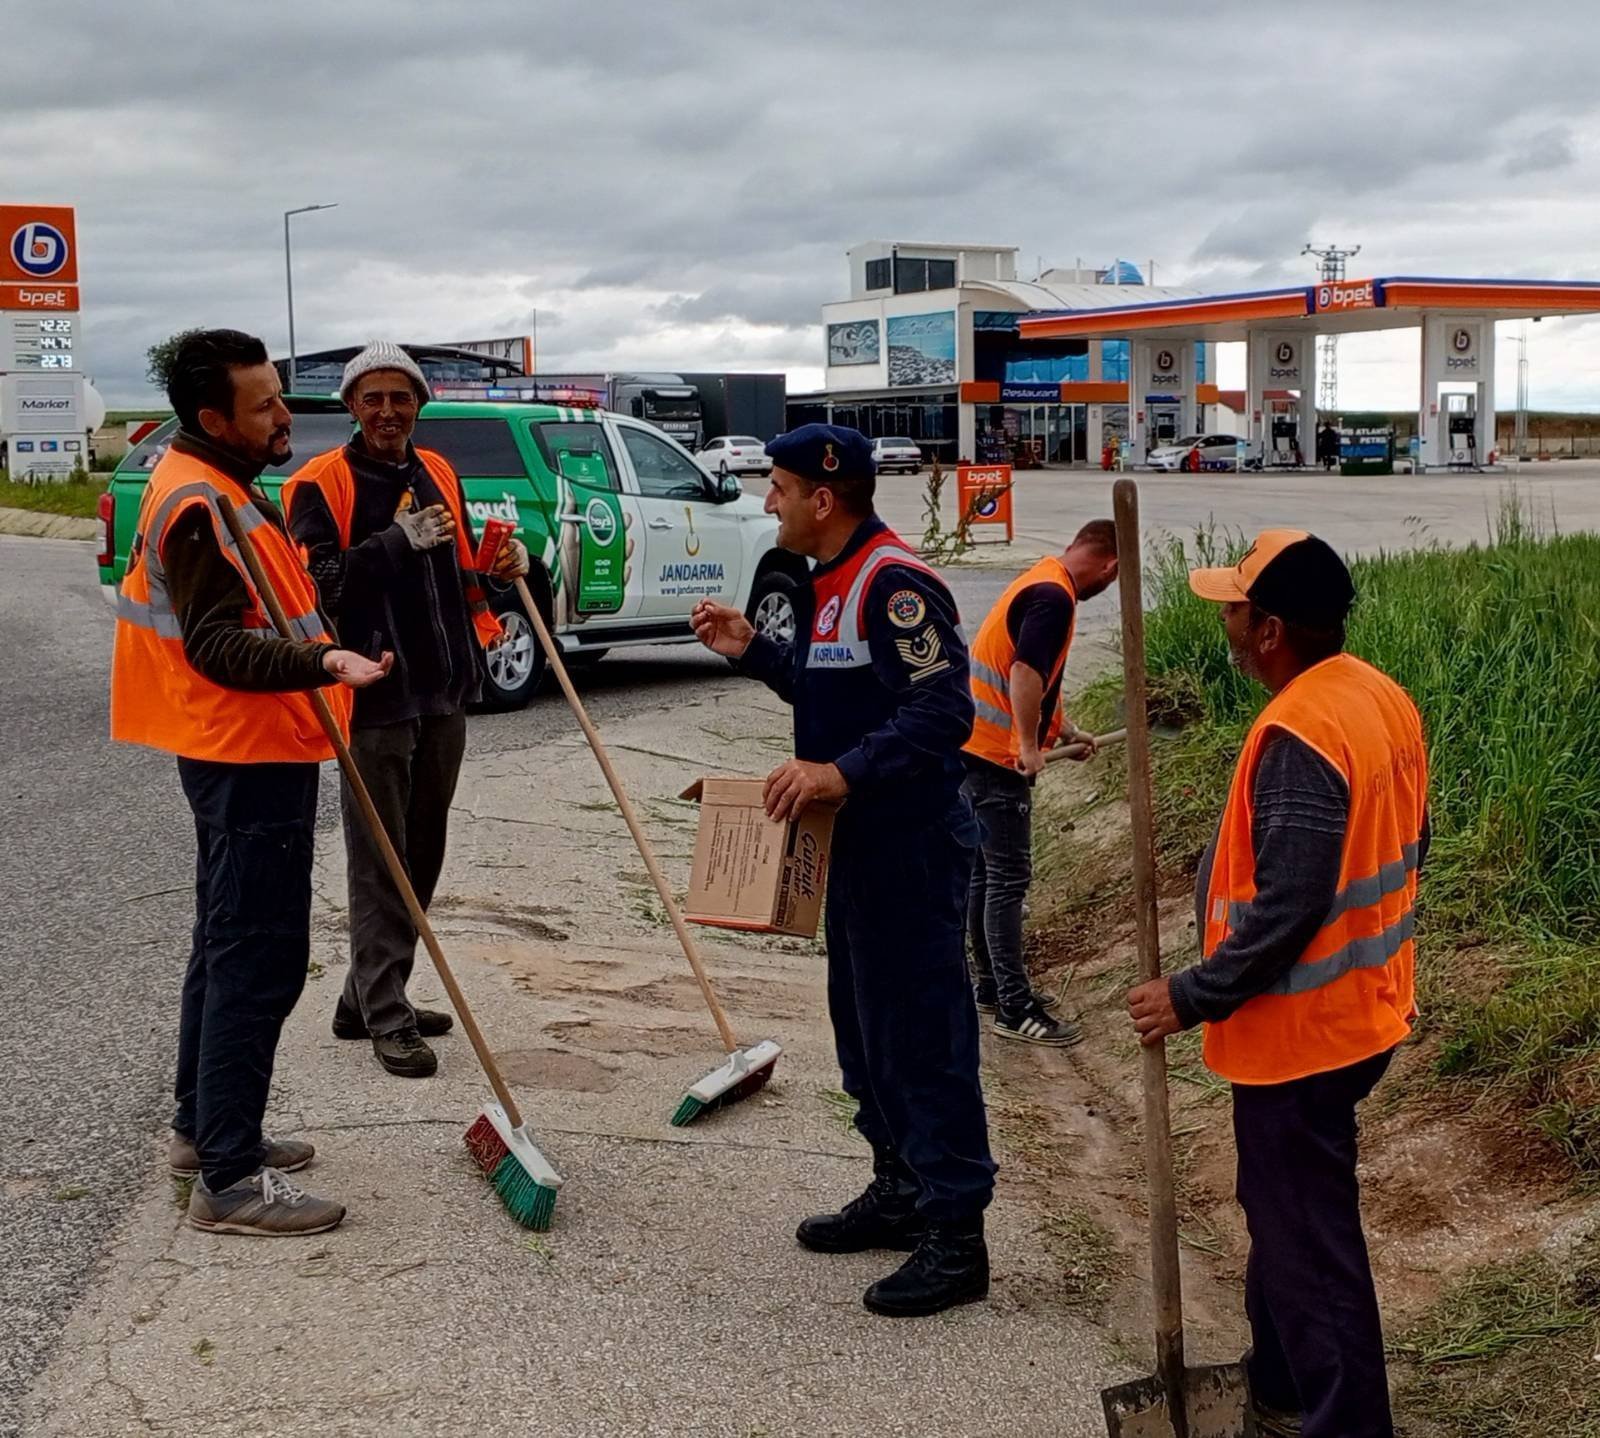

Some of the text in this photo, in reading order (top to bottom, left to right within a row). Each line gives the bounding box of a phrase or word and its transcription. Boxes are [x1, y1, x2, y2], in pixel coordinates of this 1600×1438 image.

[18, 289, 66, 306] bpet
[1333, 283, 1373, 307] bpet
[1447, 355, 1477, 370] bpet
[1152, 373, 1179, 385] bpet
[1270, 366, 1299, 379] bpet
[1002, 388, 1058, 398] Restaurant
[22, 400, 69, 409] Market
[967, 470, 1003, 484] bpet
[659, 564, 725, 582] JANDARMA
[814, 647, 855, 662] KORUMA
